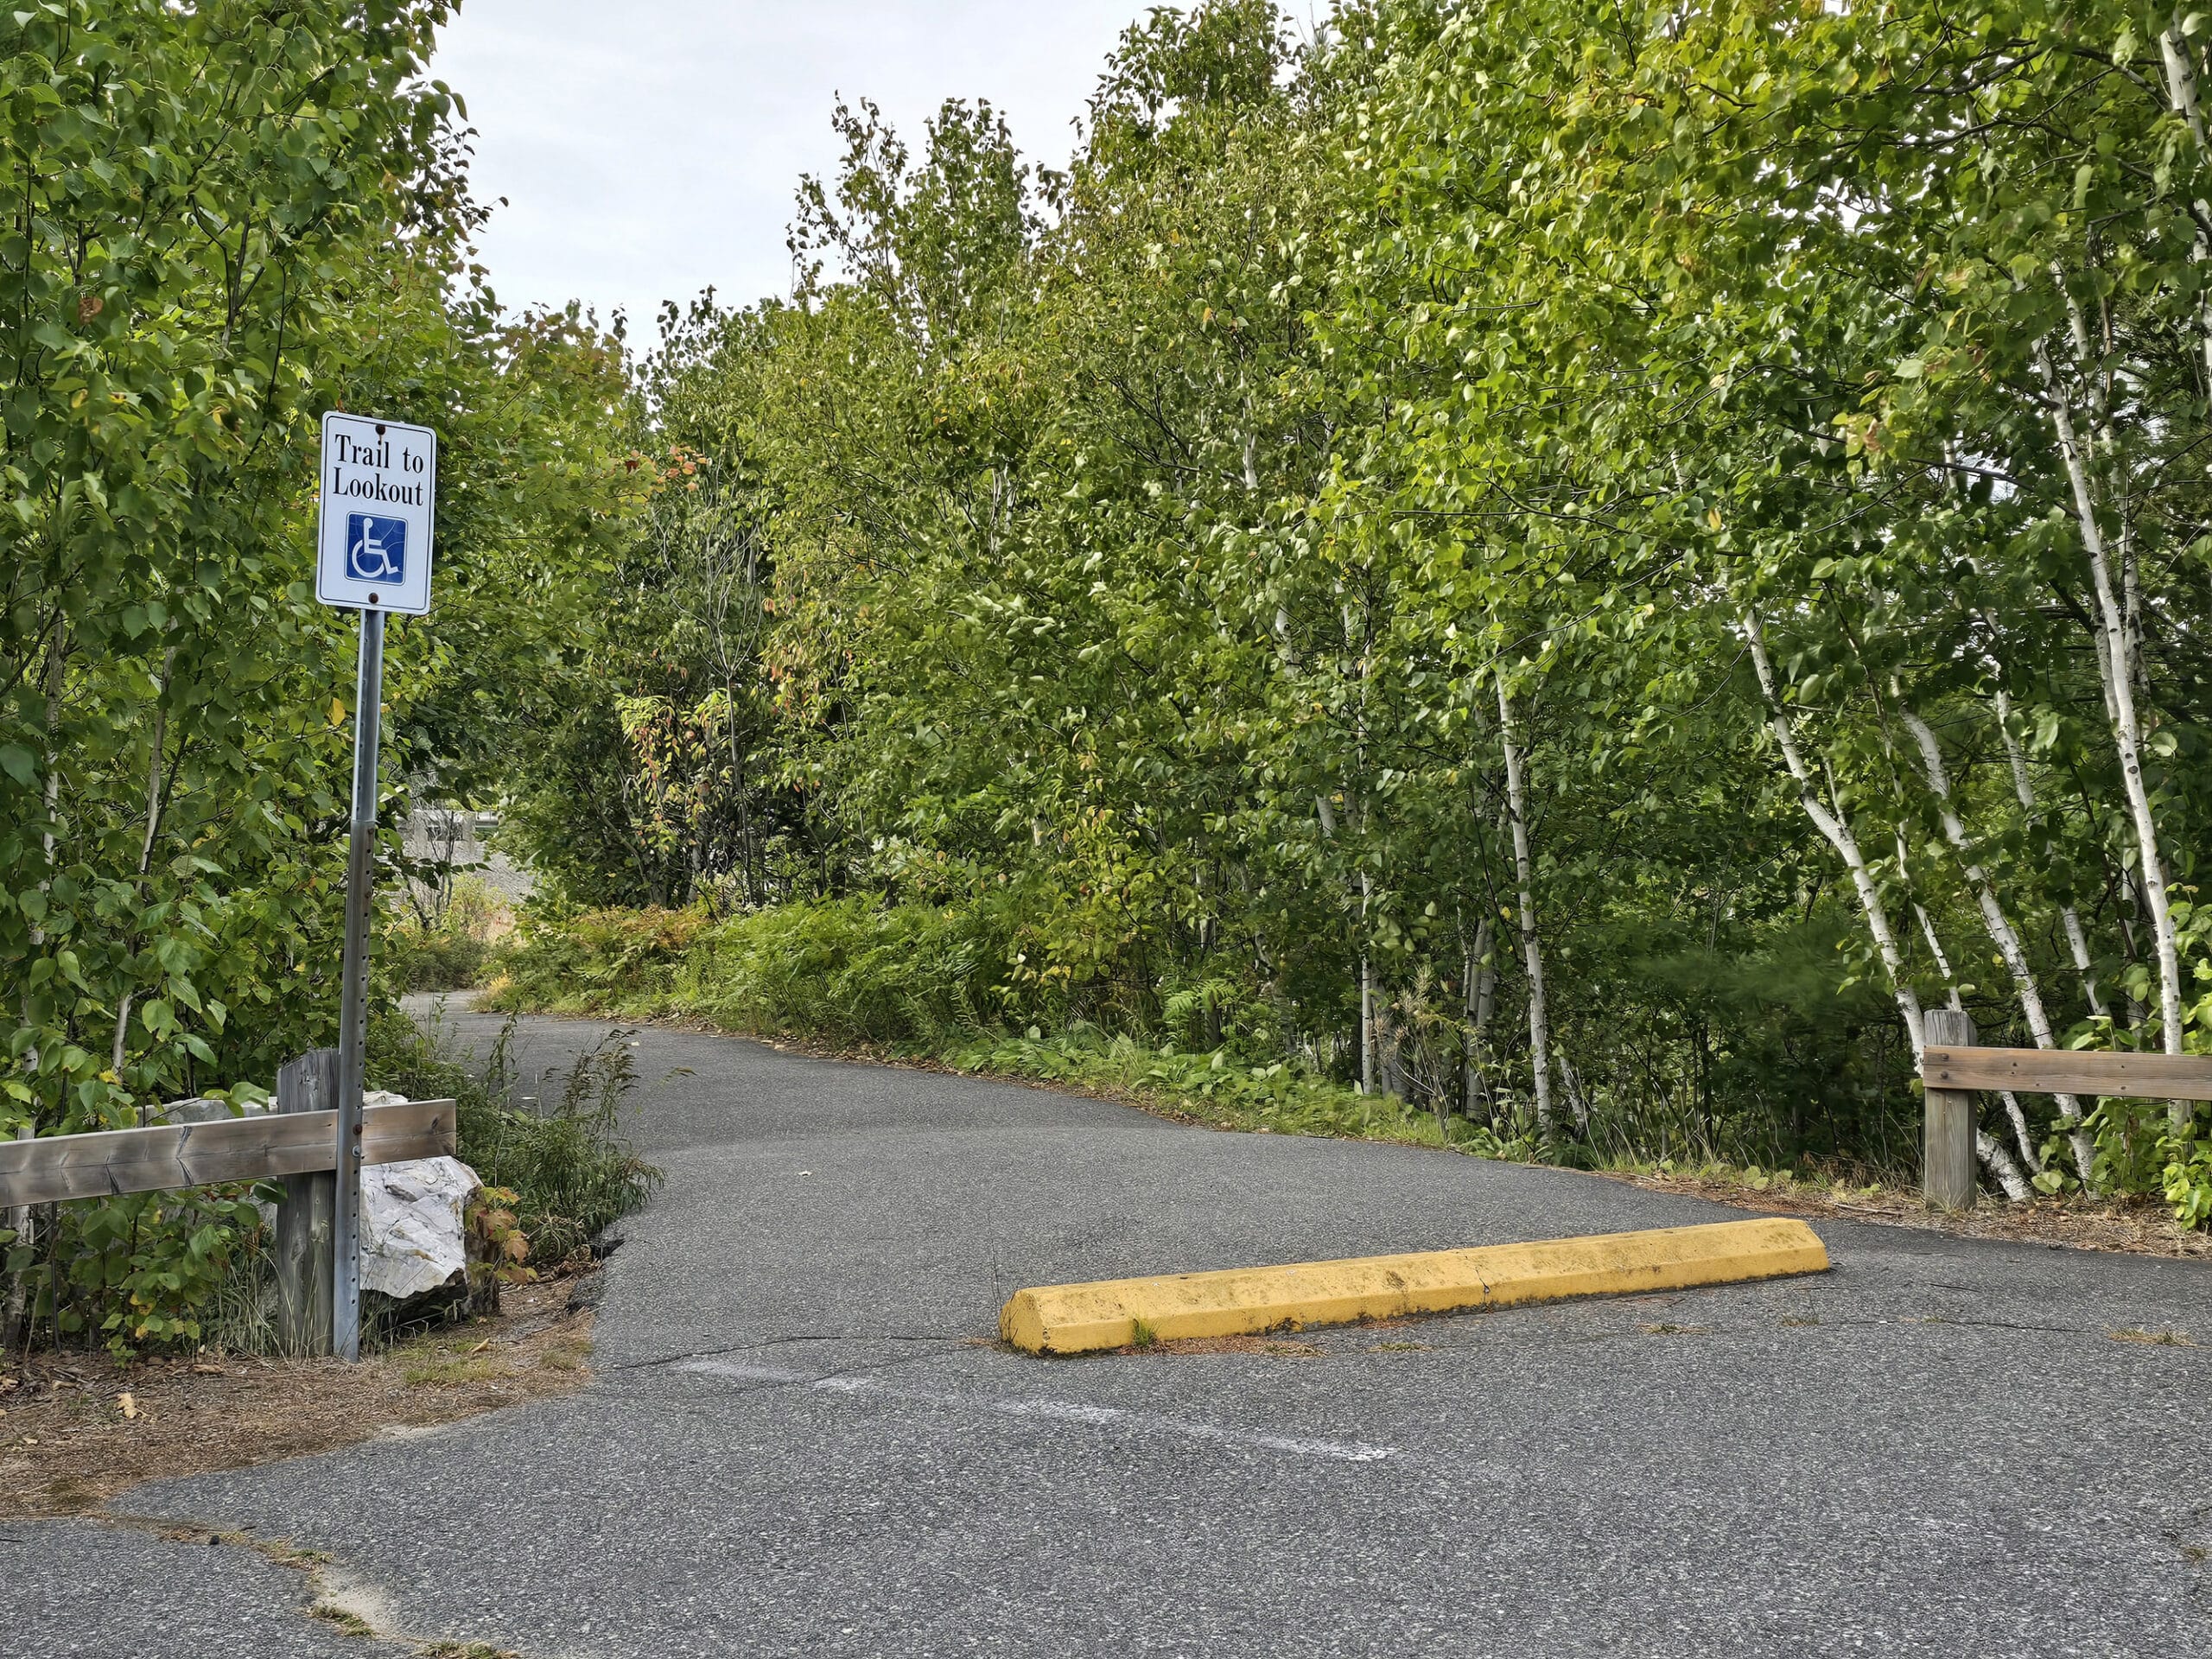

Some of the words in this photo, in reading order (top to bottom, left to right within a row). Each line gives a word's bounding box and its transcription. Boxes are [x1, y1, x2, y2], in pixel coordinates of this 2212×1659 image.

[334, 434, 390, 469] Trail
[403, 447, 424, 474] to
[333, 467, 424, 506] Lookout
